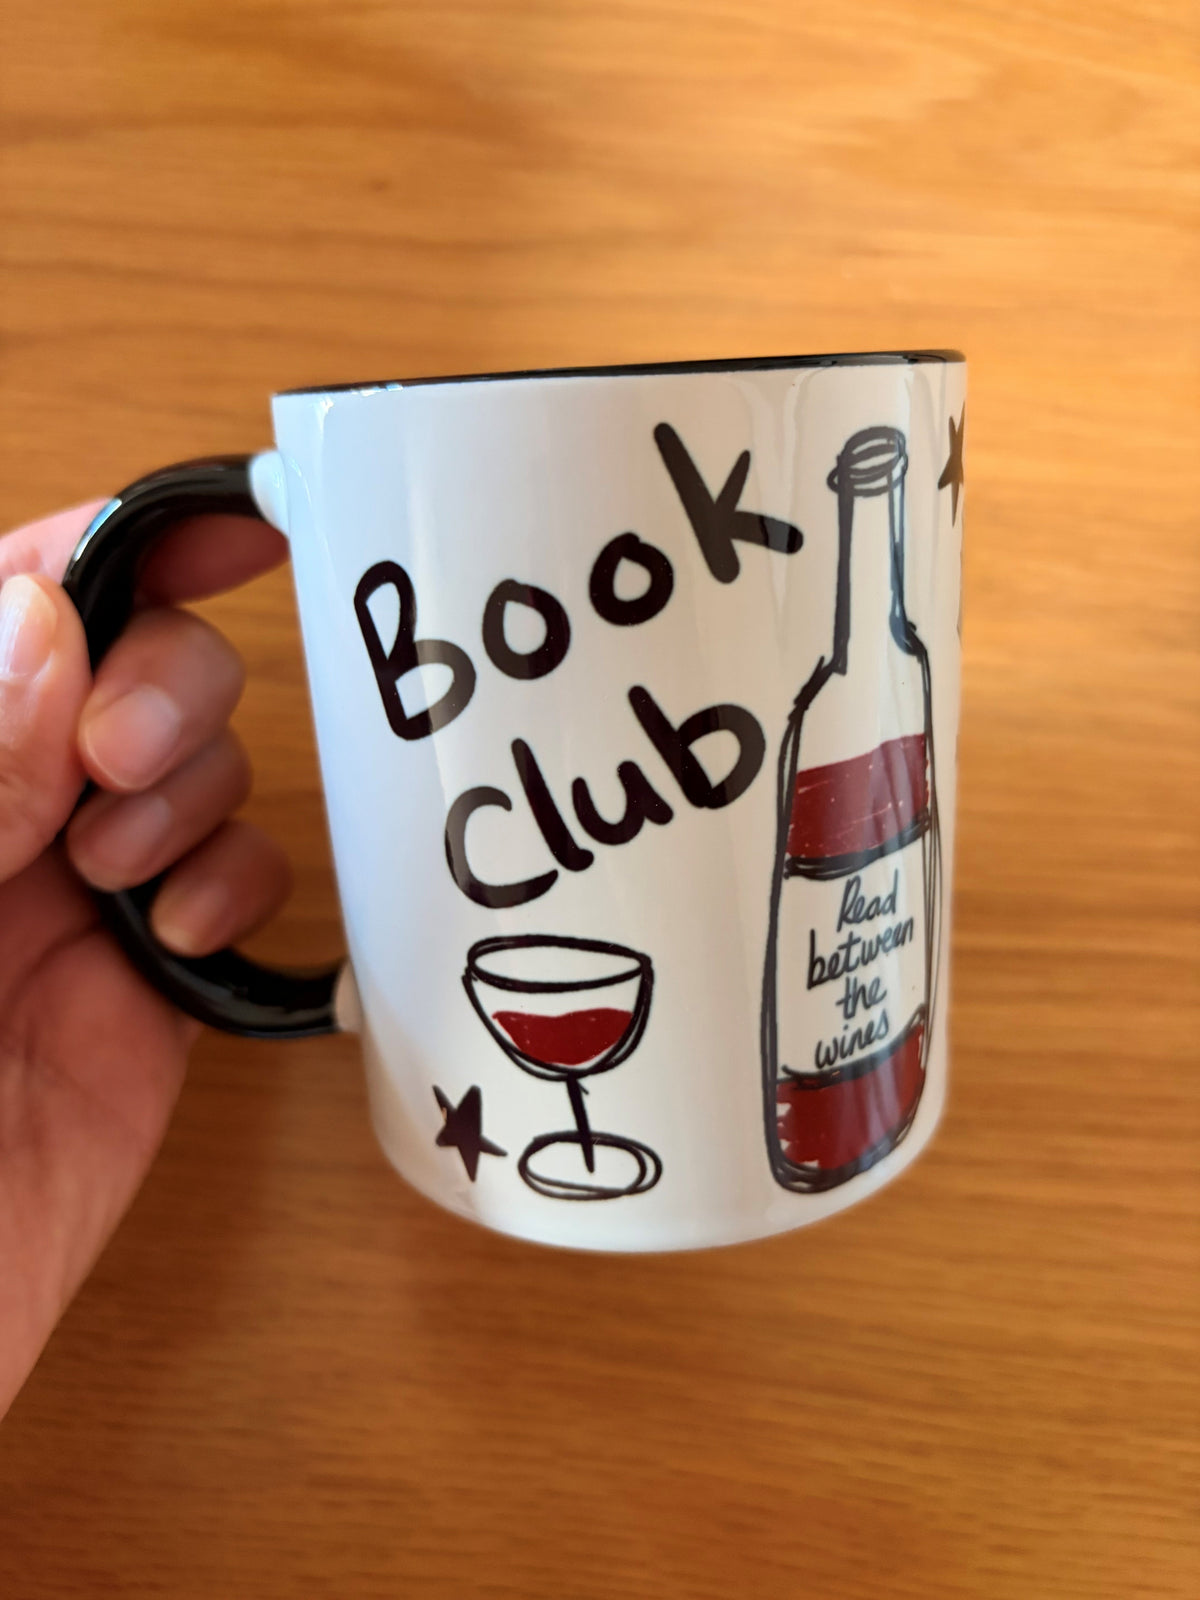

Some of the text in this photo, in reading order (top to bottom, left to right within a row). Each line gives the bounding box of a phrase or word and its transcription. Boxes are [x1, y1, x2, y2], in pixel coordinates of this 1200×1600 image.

[354, 422, 804, 741] Book
[444, 685, 766, 909] Club
[837, 868, 898, 932] Read
[807, 917, 914, 990] between
[836, 976, 887, 1019] the
[815, 1009, 889, 1069] wines
